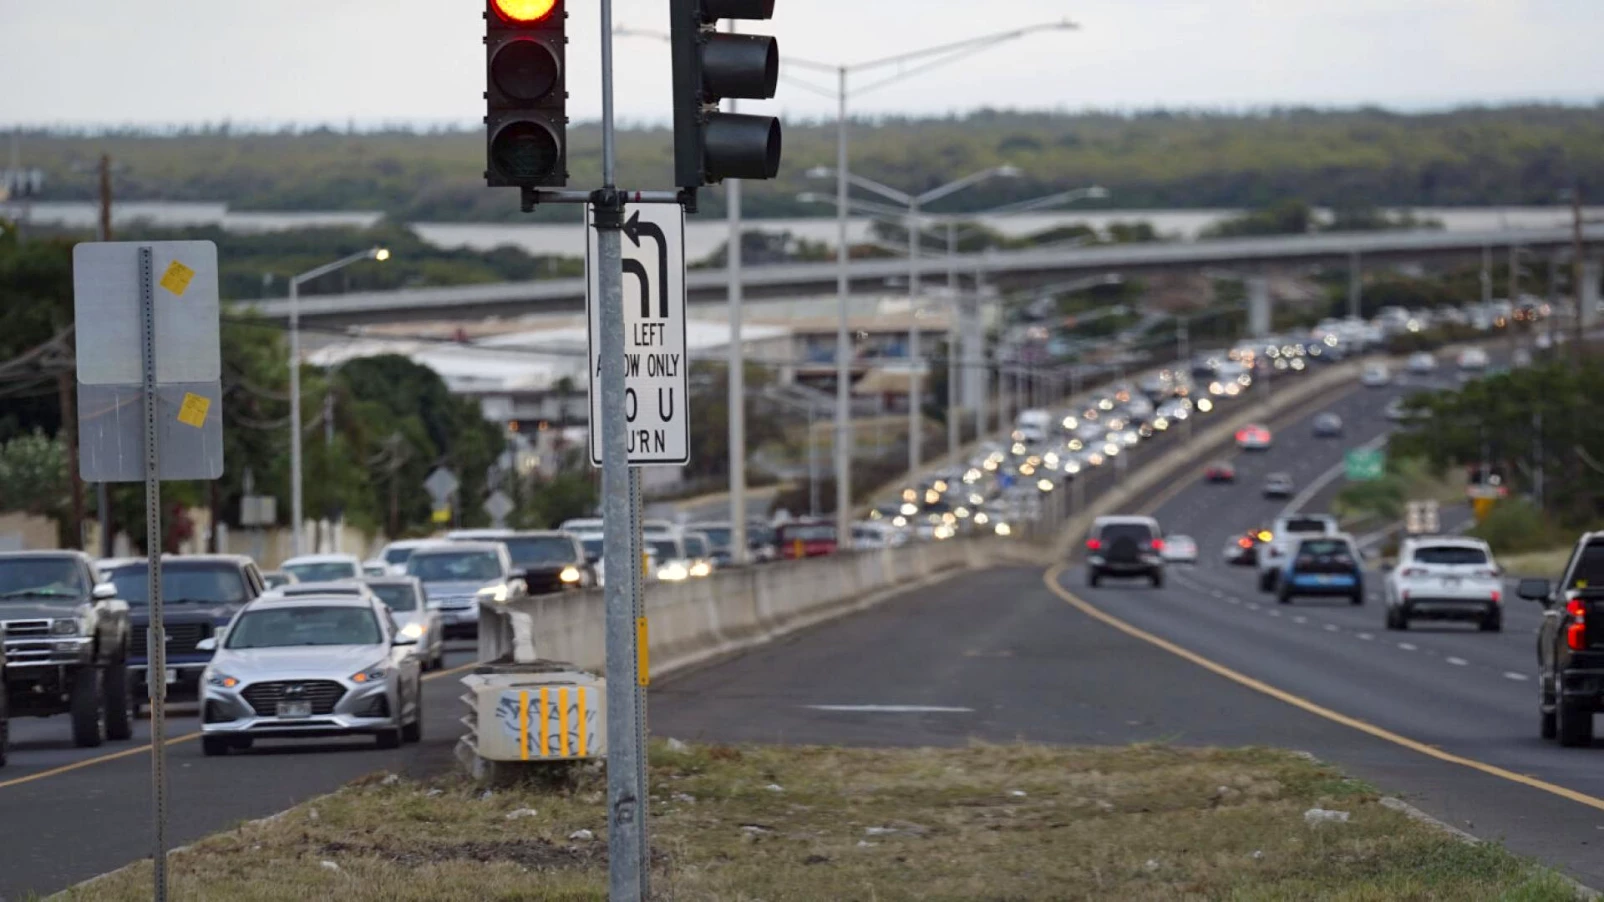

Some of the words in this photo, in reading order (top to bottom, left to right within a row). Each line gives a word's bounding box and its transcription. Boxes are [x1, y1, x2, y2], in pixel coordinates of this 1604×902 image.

[634, 323, 665, 346] LEFT
[647, 353, 679, 377] ONLY
[658, 387, 673, 422] U
[627, 429, 665, 453] URN
